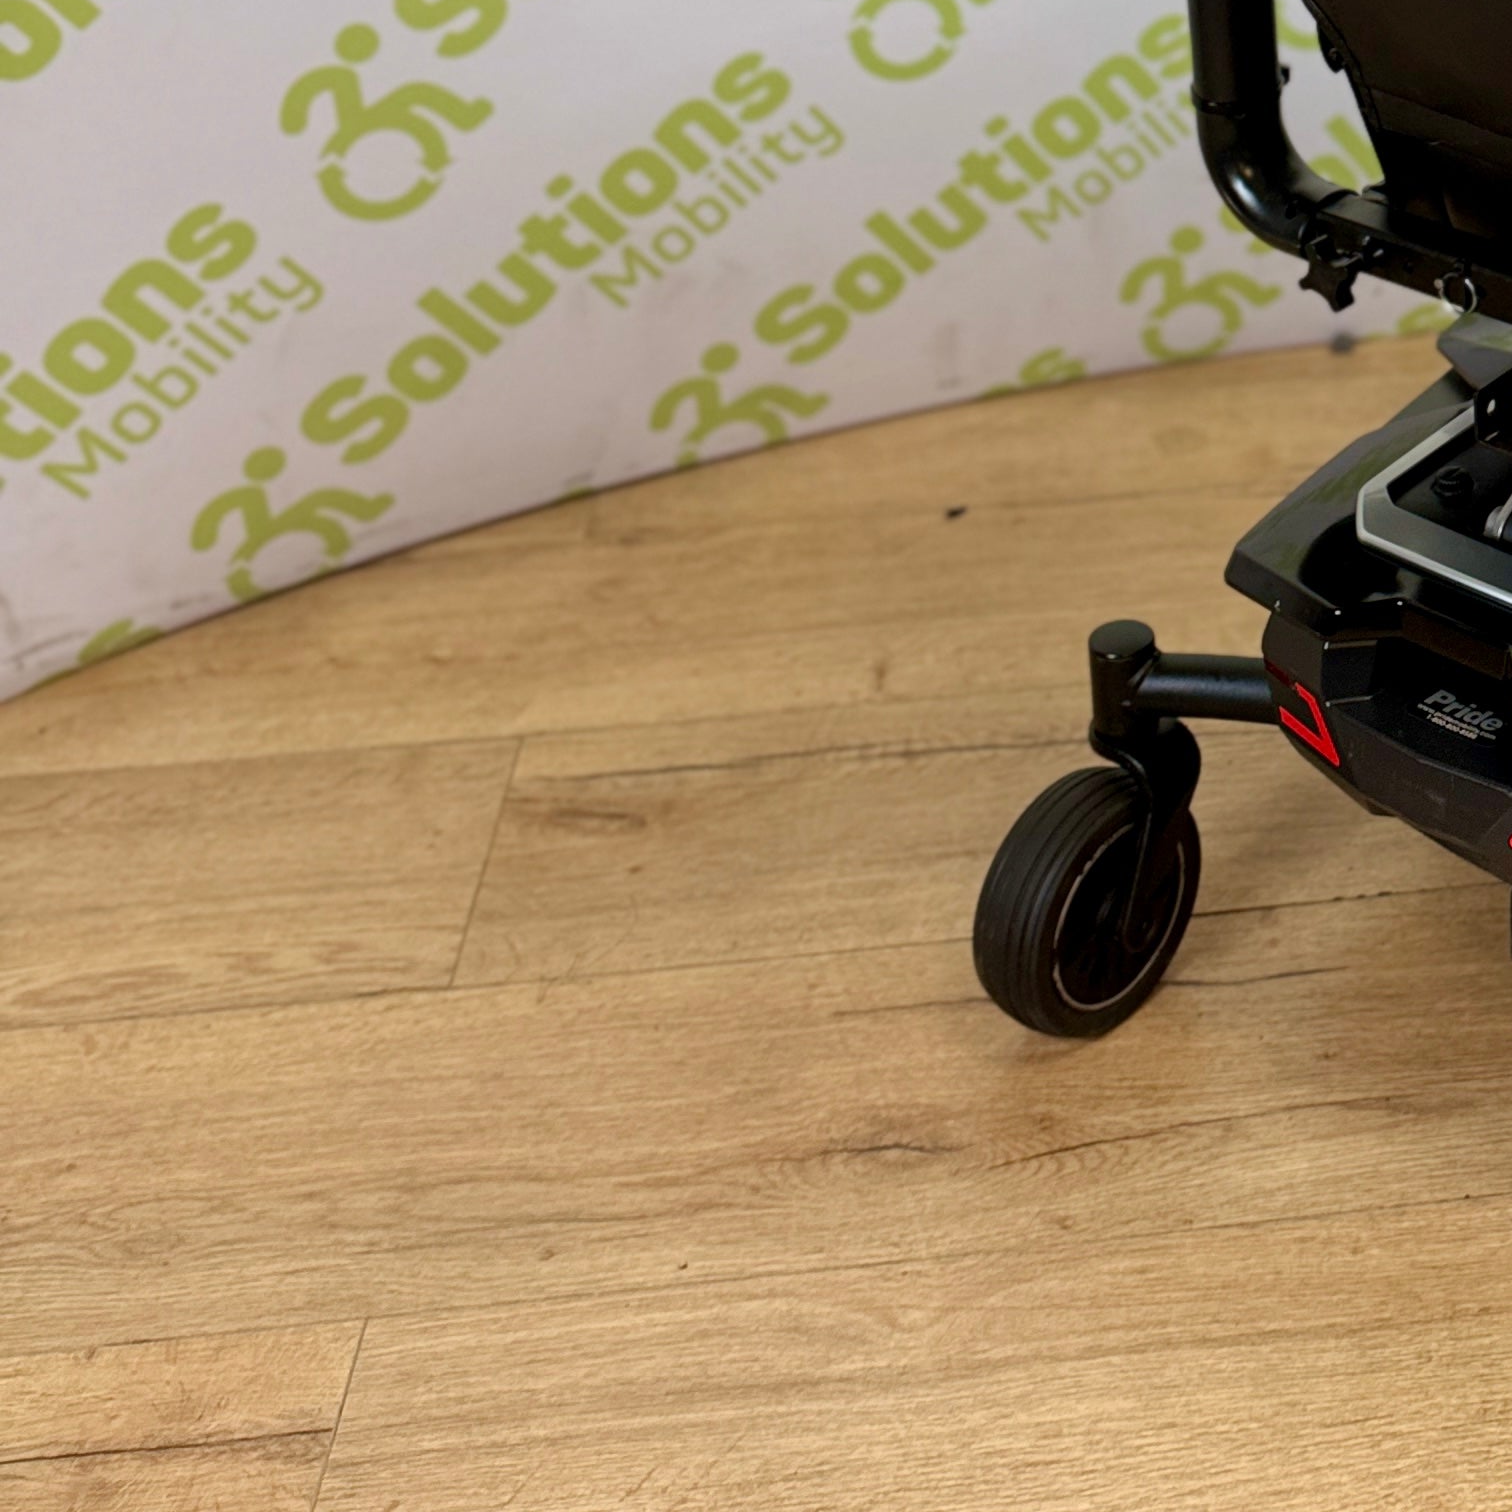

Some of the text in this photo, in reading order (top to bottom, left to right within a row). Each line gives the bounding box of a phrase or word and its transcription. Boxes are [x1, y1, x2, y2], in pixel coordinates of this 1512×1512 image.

[301, 52, 792, 465] Solutions
[590, 105, 846, 308] Mobility
[754, 14, 1192, 365] Solutions
[41, 255, 324, 501] Mobility
[1423, 689, 1504, 731] Pride
